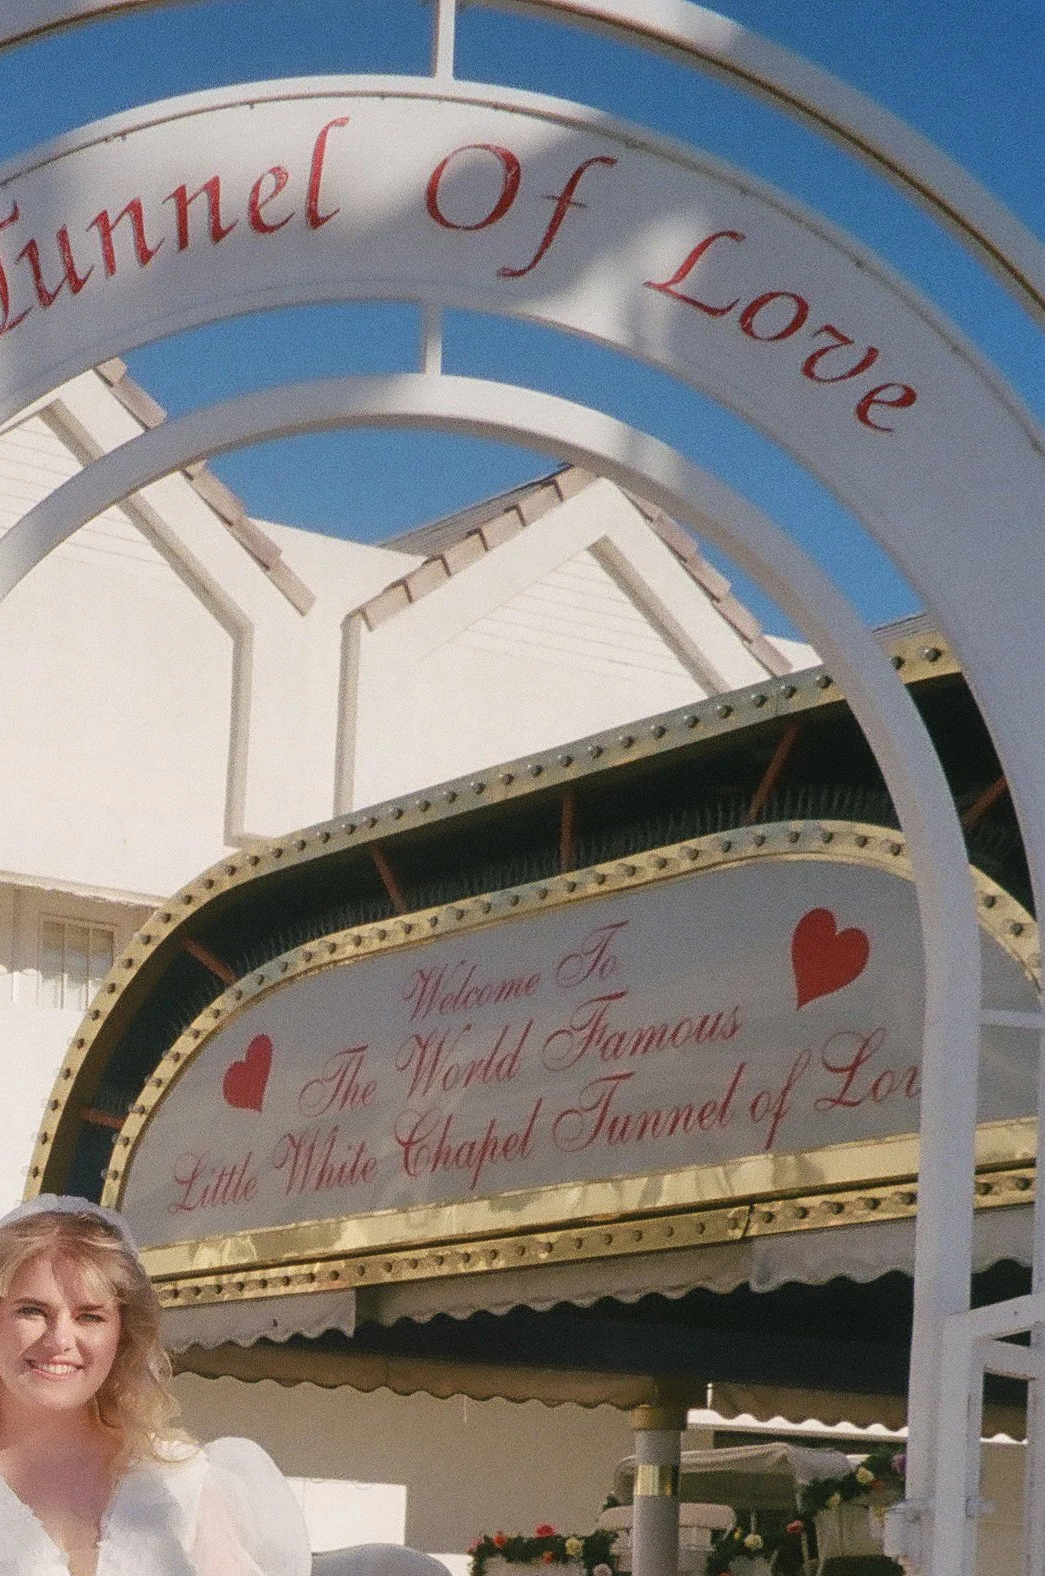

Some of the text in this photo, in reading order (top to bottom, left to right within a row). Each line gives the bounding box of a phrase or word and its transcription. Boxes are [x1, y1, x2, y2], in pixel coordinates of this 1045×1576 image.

[424, 143, 617, 278] Of
[642, 229, 918, 433] Love
[404, 919, 631, 1022] Welcome To
[298, 990, 743, 1118] The World Famous
[167, 1150, 259, 1216] Little
[273, 1124, 379, 1196] White
[394, 1097, 543, 1190] Chapel
[552, 1062, 748, 1153] Tunnel
[750, 1048, 813, 1151] of
